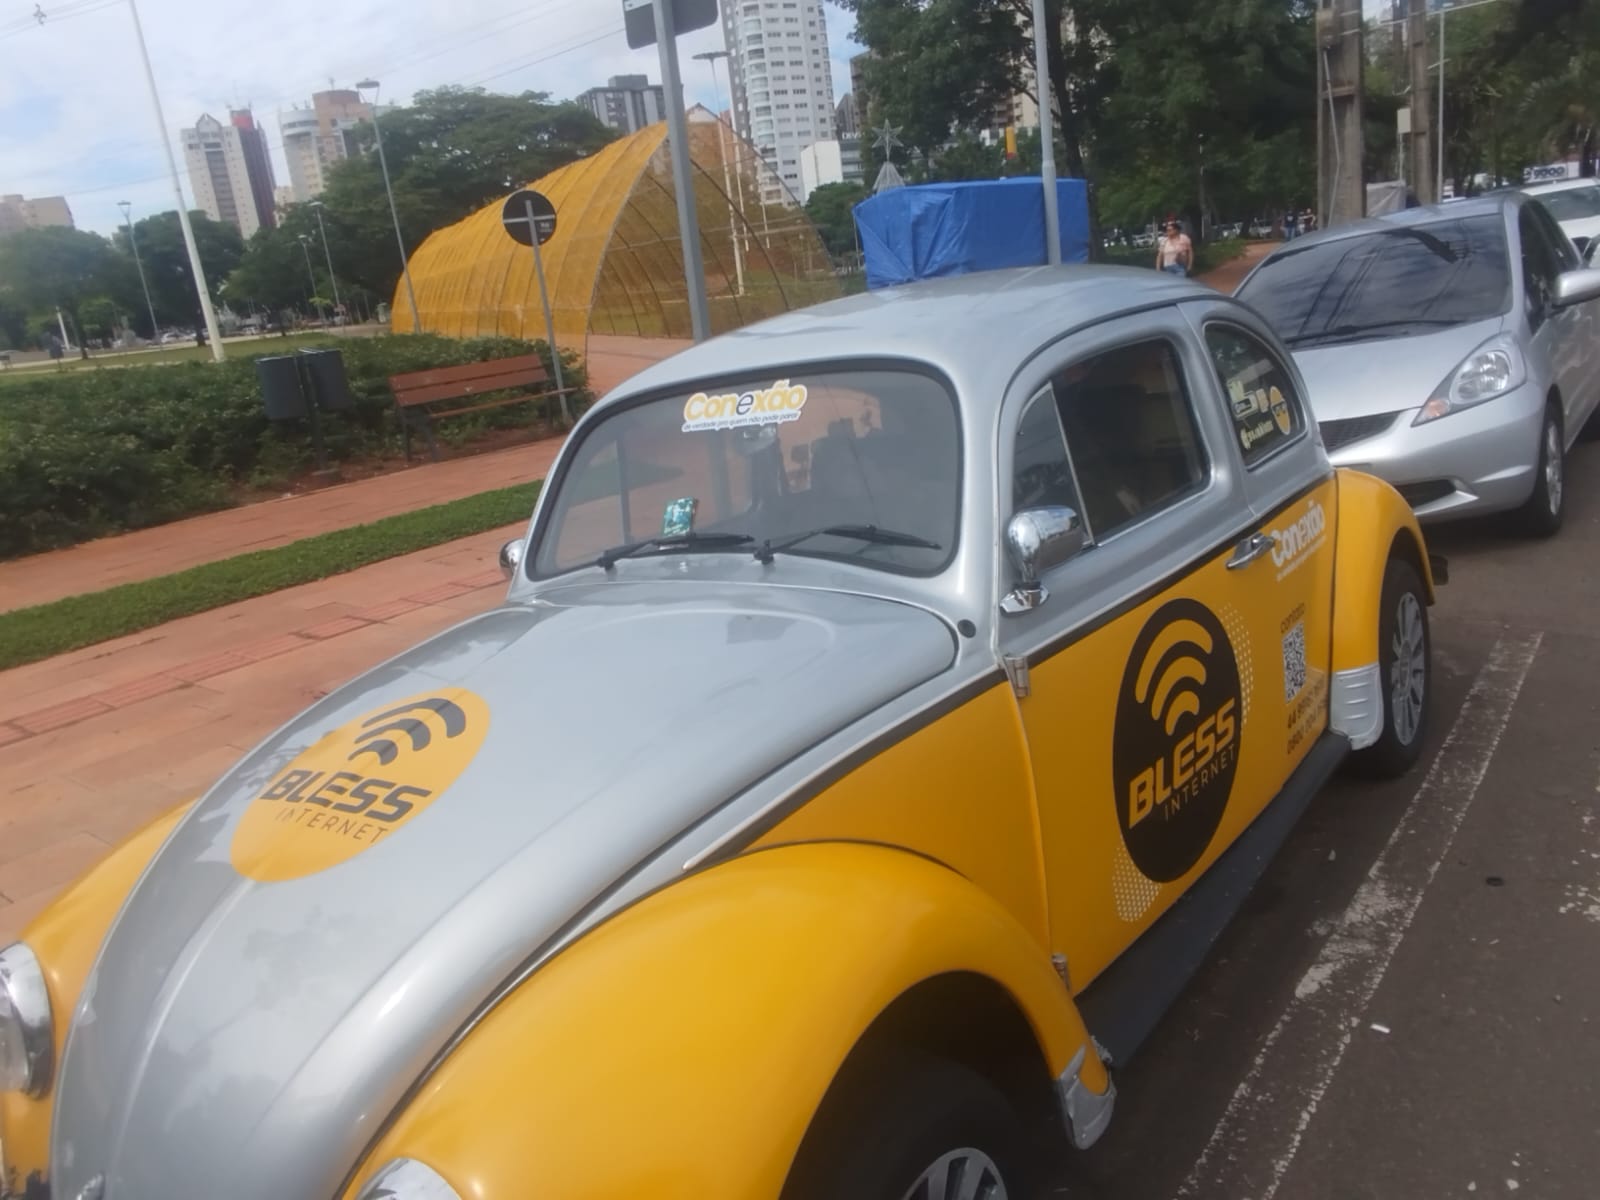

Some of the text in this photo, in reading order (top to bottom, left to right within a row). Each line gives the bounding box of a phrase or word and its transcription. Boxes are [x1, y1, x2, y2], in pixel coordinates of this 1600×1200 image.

[685, 380, 806, 421] Conexão
[1128, 697, 1236, 830] BLESS
[1163, 743, 1235, 821] INTERNET
[259, 769, 433, 823] BLESS
[275, 807, 389, 843] INTERNET
